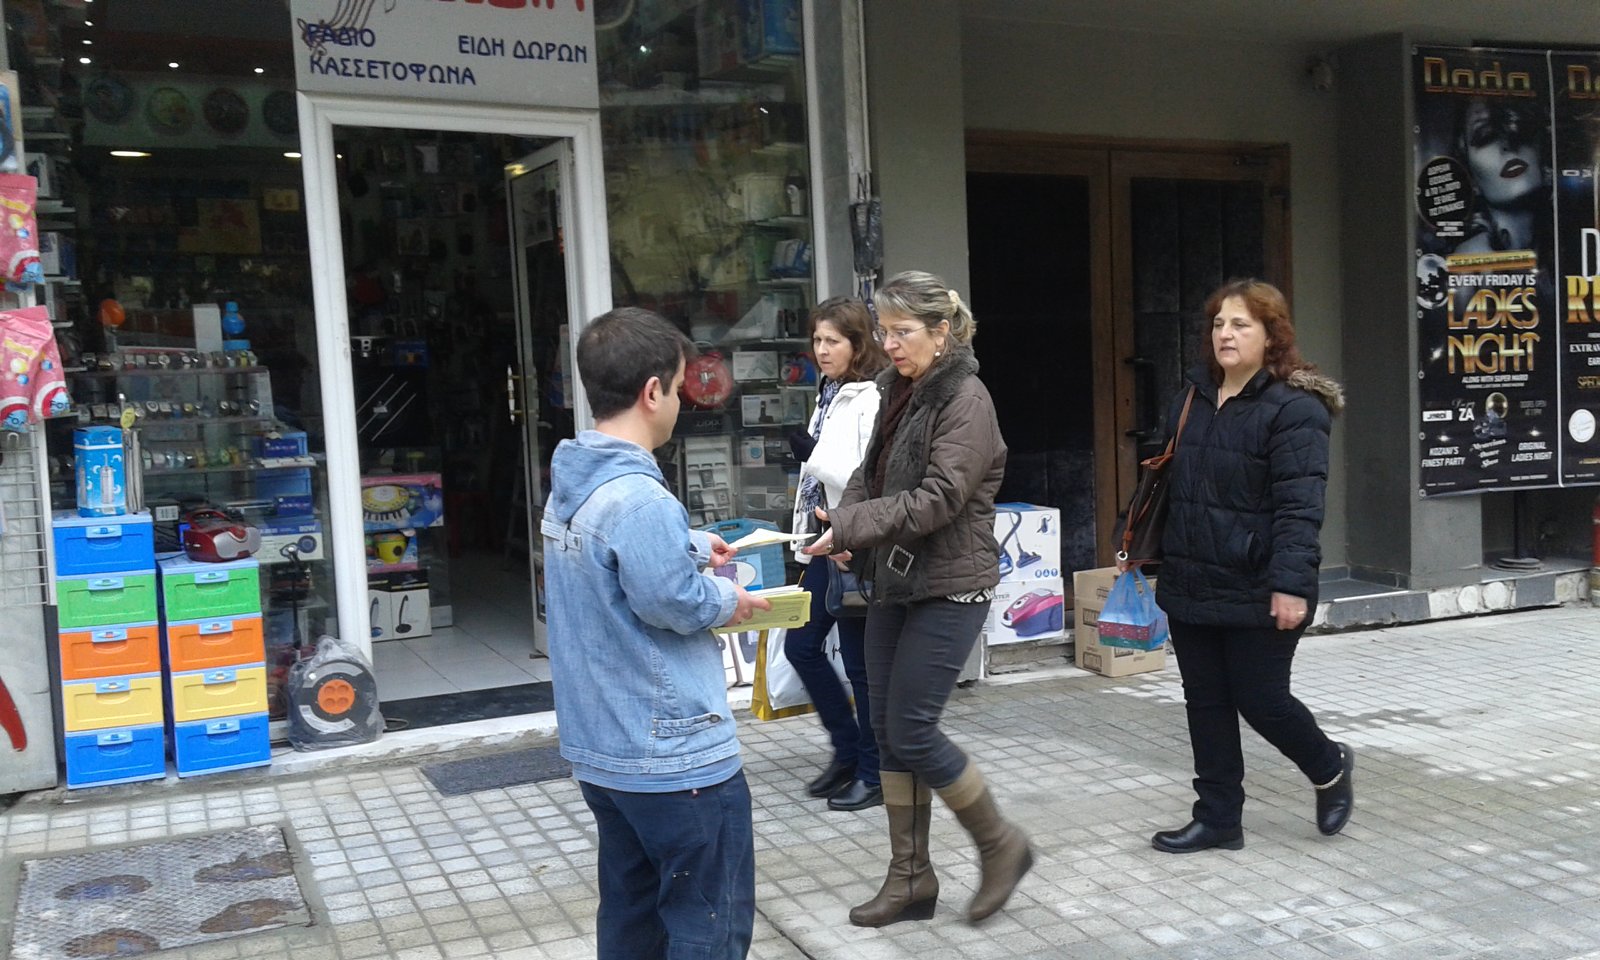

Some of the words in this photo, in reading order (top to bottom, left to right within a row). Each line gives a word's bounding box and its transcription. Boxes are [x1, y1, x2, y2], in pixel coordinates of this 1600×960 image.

[458, 35, 505, 57] ΕΙΔΗ
[513, 40, 587, 63] ΔΩΡΩΝ
[310, 56, 476, 85] ΚΑΣΣΕΤΟΦΩΝΑ
[1448, 274, 1483, 287] EVERY
[1485, 274, 1524, 287] FRIDAY
[1525, 274, 1537, 286] IS
[1447, 287, 1541, 330] LADIES
[1447, 332, 1541, 375] NIGHT
[1421, 458, 1444, 468] FINEST
[1445, 456, 1466, 466] PARTY
[1511, 452, 1533, 462] LADIES
